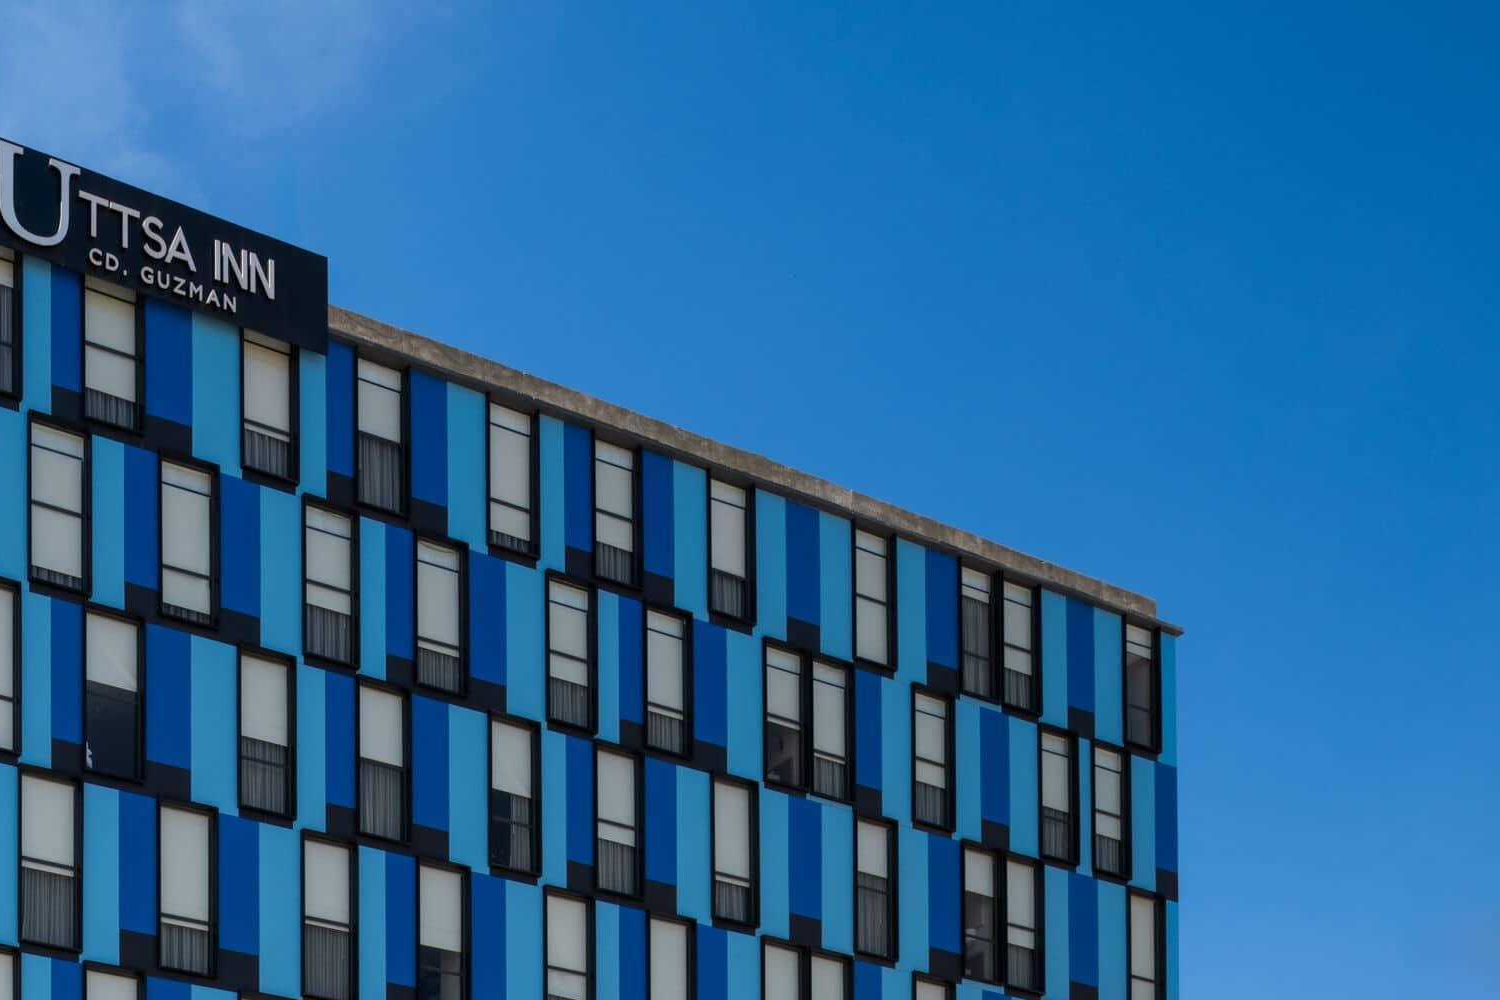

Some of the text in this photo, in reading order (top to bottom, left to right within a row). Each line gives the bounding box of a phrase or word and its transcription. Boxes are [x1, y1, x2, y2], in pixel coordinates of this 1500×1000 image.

[88, 247, 237, 313] CD. GUZMAN
[214, 239, 275, 300] INN
